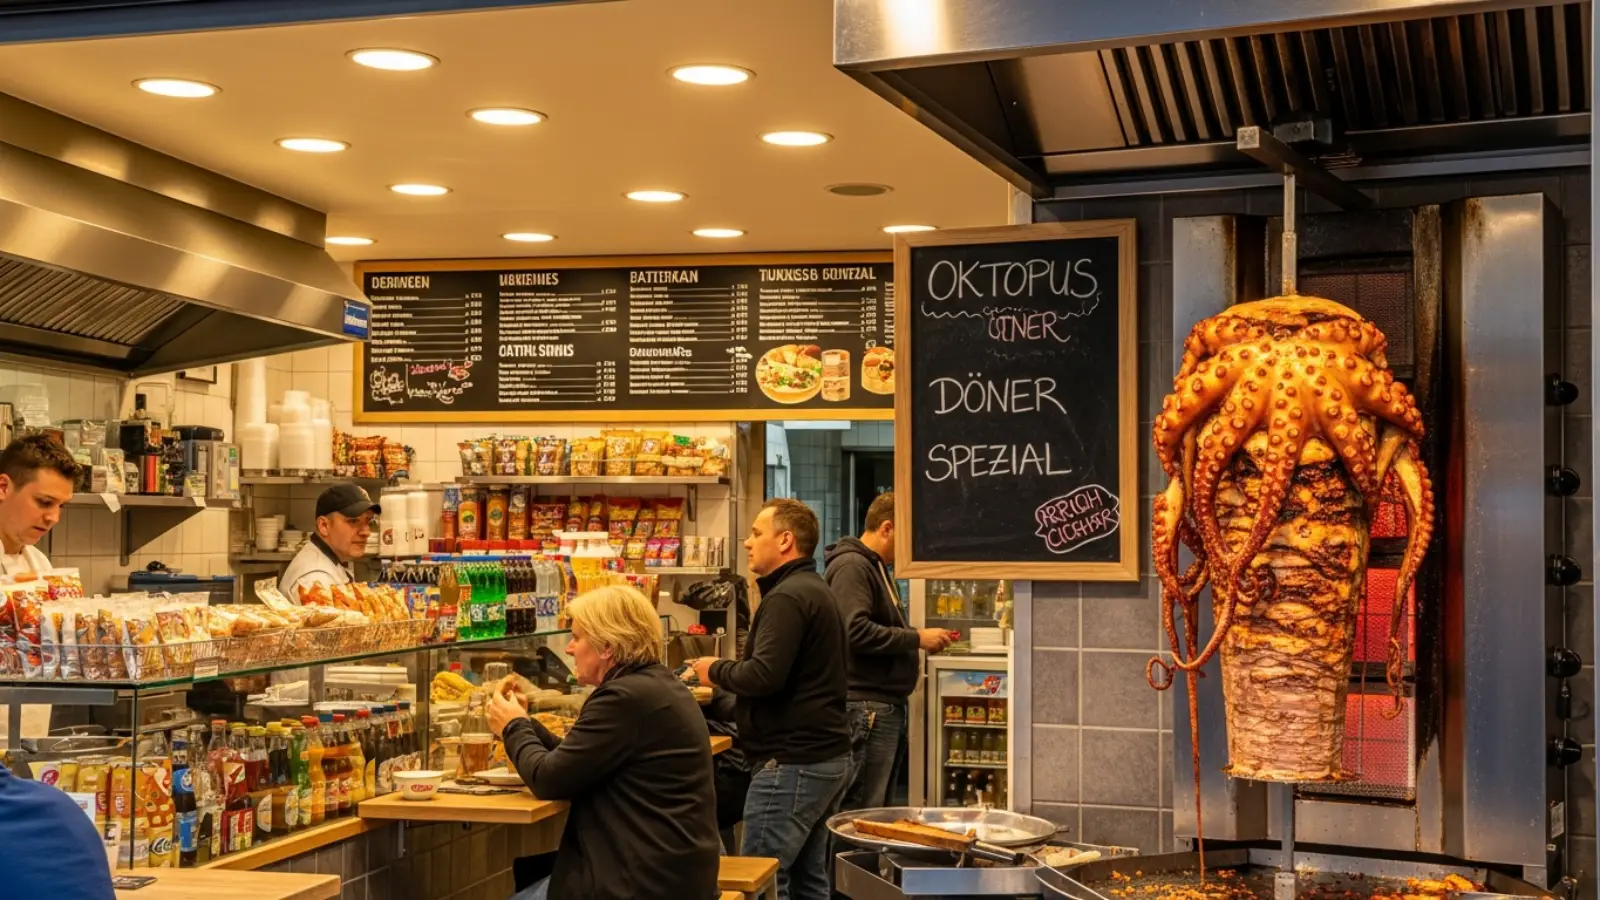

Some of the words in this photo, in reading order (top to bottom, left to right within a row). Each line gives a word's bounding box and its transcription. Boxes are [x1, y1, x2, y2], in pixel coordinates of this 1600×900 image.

[928, 259, 1099, 302] OKTOPUS
[928, 371, 1068, 415] DÖNER
[925, 441, 1073, 483] SPEZIAL
